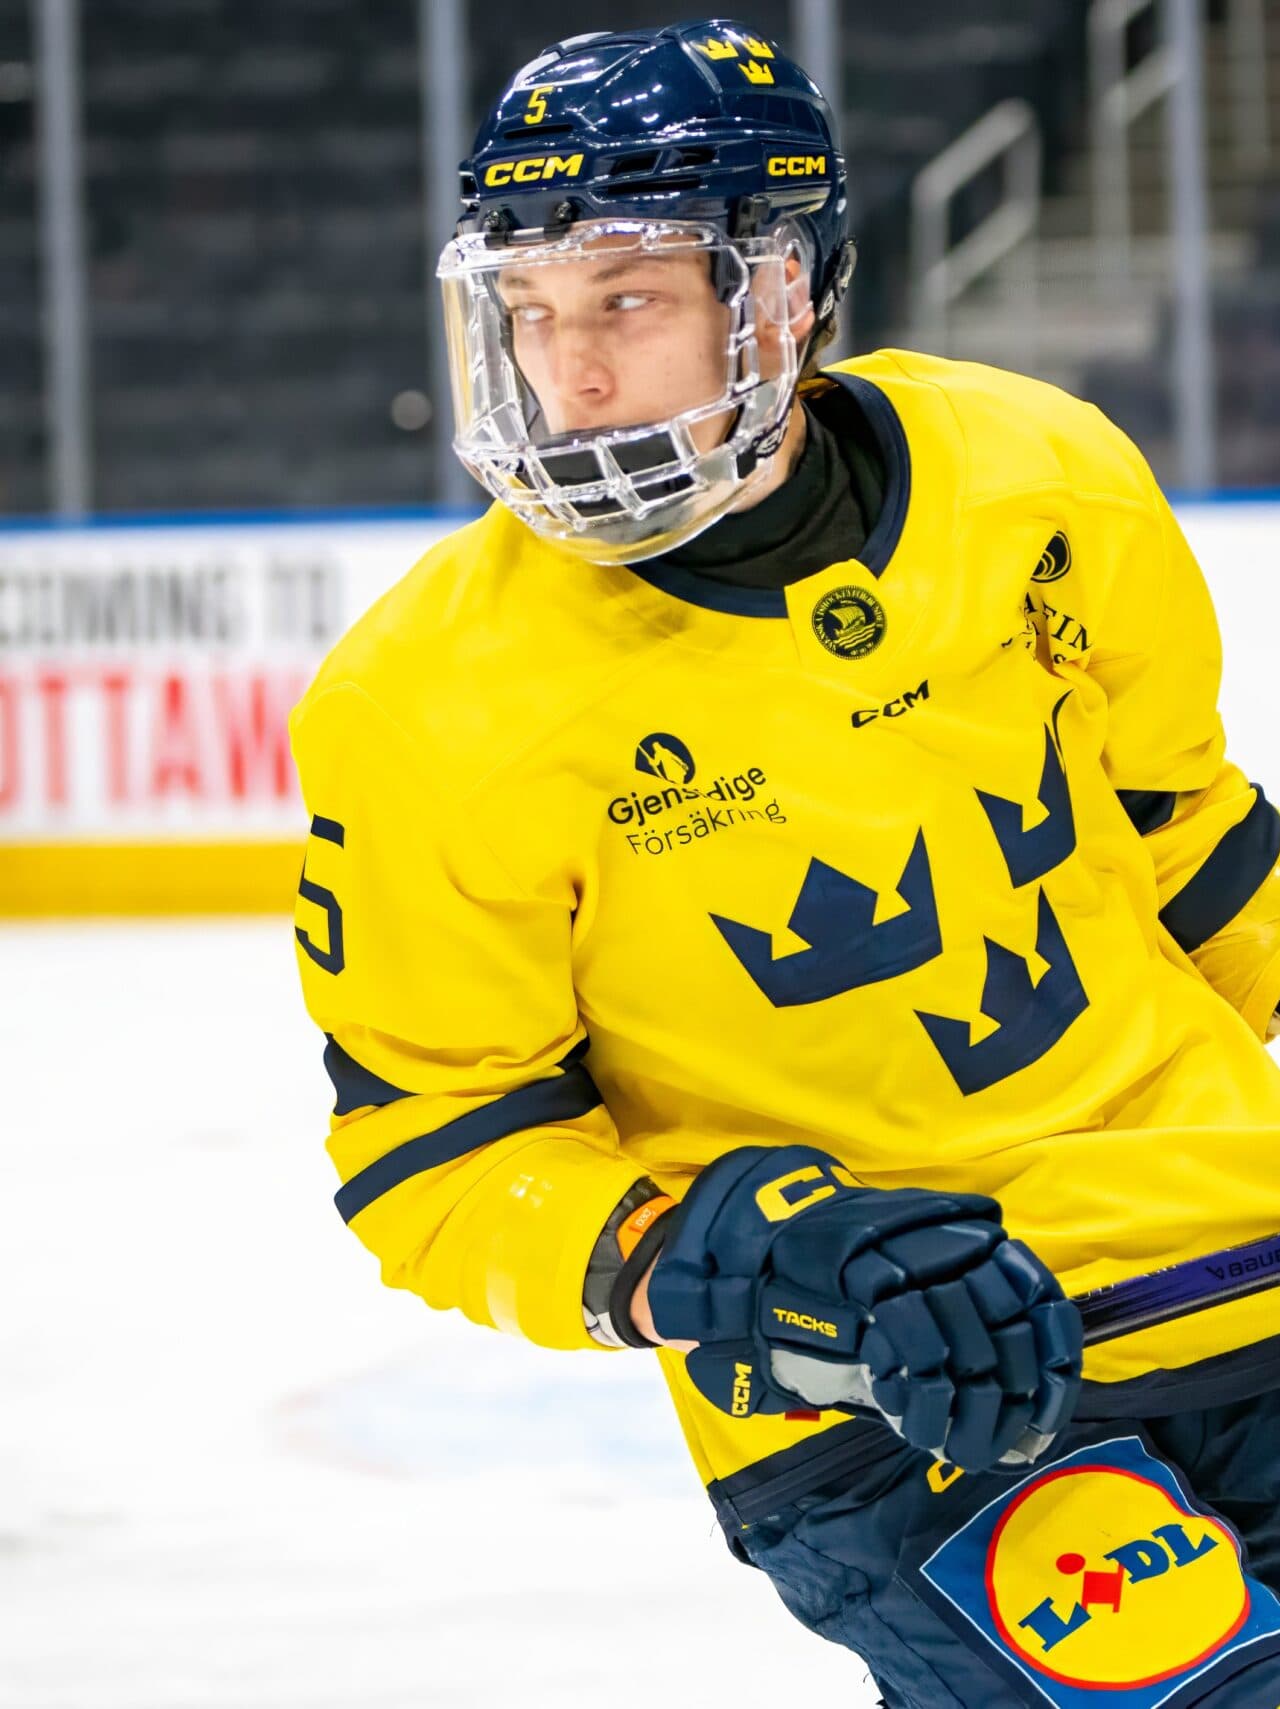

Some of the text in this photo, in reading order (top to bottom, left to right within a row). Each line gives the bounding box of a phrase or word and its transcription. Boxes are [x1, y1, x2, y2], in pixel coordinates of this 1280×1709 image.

[523, 86, 555, 125] 5
[484, 153, 585, 188] CCM
[767, 155, 826, 176] CCM
[850, 679, 931, 729] CCM
[0, 668, 308, 812] TTAW
[607, 767, 767, 827] Gjensdige
[295, 813, 346, 977] 5
[772, 1307, 839, 1339] TACKS
[731, 1362, 753, 1417] CCM
